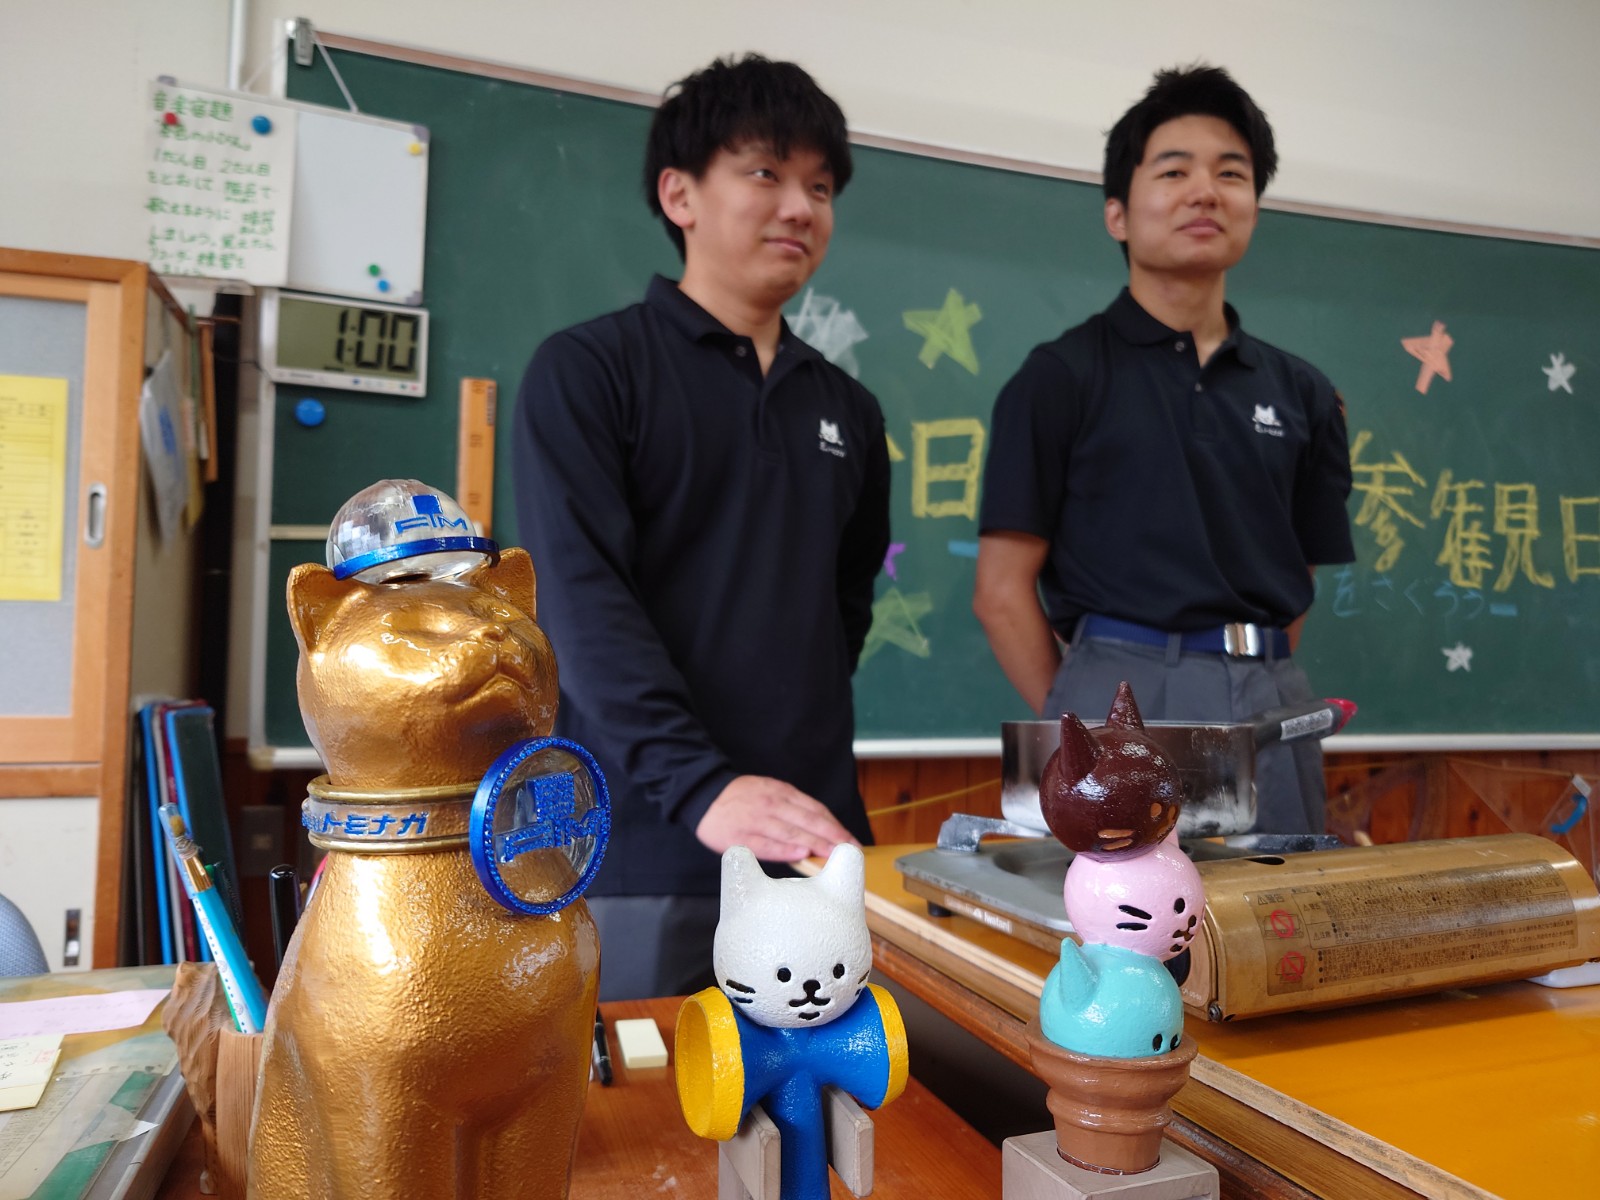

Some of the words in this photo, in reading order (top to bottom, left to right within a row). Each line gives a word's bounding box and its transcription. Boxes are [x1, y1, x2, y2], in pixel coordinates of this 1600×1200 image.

[336, 310, 420, 372] 1:00
[886, 418, 985, 521] 日
[302, 811, 429, 835] トミナガ
